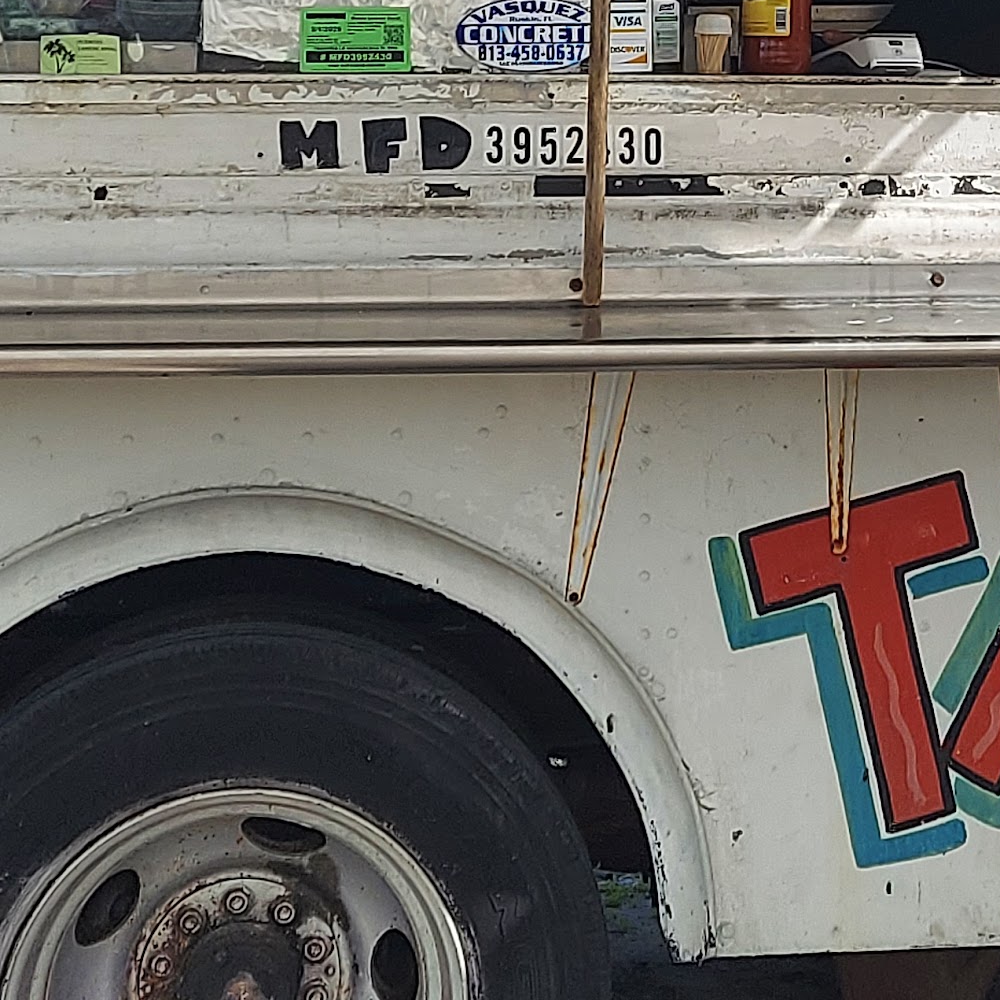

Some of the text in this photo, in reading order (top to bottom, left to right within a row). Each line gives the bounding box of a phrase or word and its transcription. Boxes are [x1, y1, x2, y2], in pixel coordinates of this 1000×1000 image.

[471, 0, 586, 23] VASQUEZ
[614, 16, 643, 27] VISA
[486, 126, 663, 165] 395230
